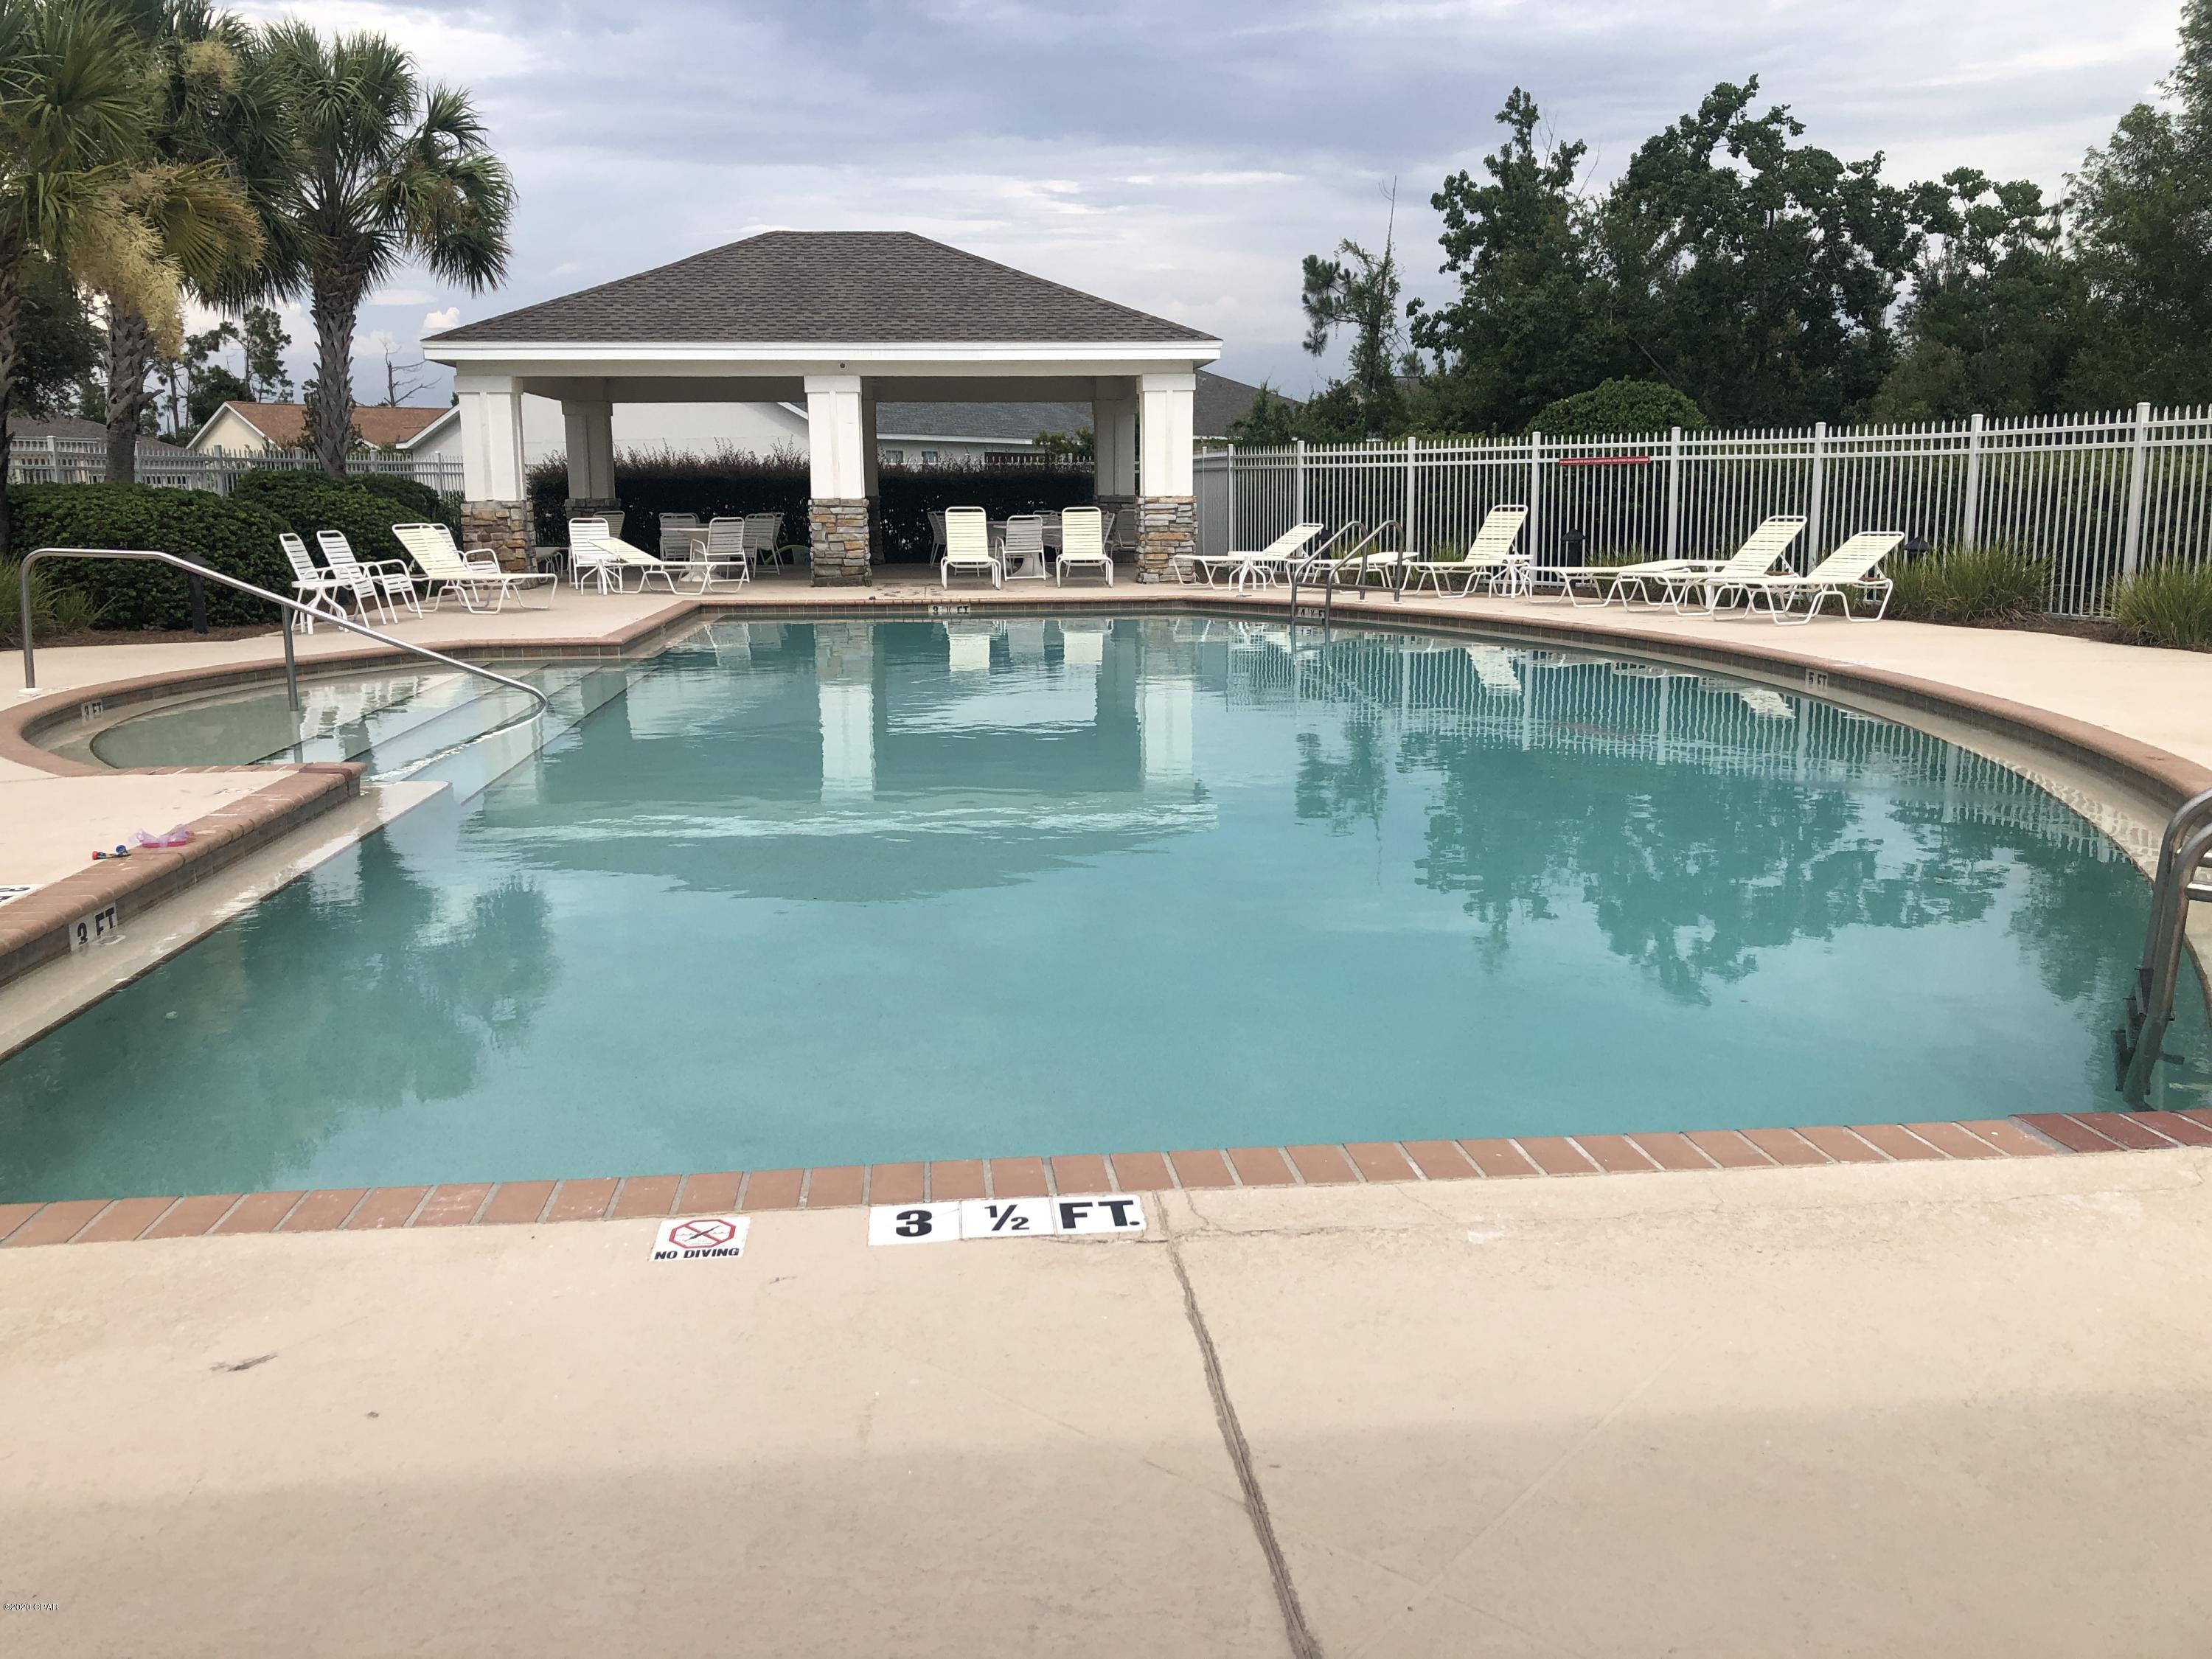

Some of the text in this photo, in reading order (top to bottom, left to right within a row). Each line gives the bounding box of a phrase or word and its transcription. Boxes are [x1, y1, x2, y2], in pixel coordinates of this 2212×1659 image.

[1809, 672, 1827, 685] 5 FT
[92, 701, 101, 714] FT
[77, 922, 88, 945] 3
[896, 1209, 933, 1237] 3
[1059, 1200, 1141, 1229] FT.
[654, 1248, 740, 1260] NO DIVING
